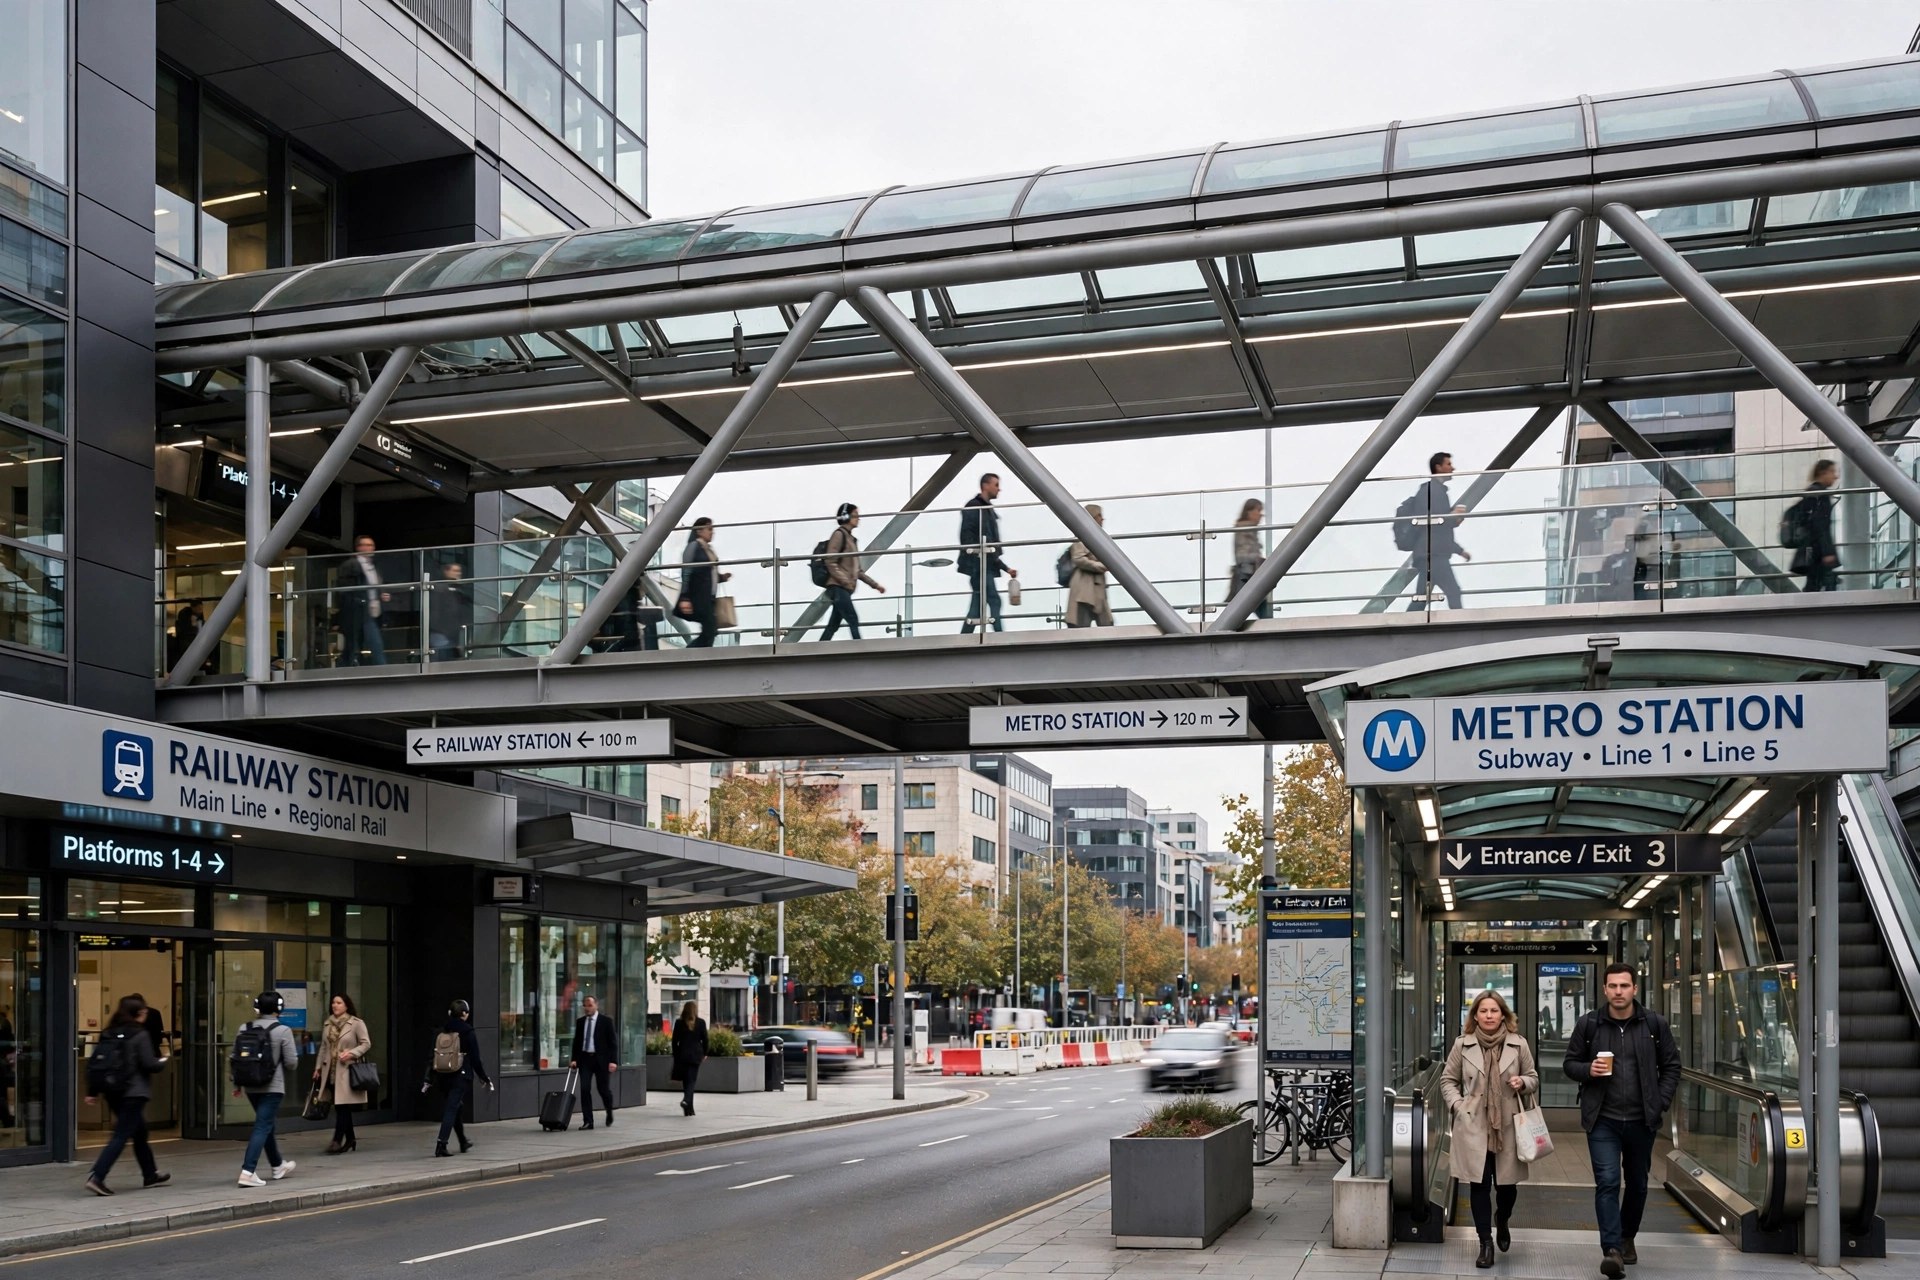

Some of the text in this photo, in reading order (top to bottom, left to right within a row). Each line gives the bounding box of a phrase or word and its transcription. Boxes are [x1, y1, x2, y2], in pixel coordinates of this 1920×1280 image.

[1005, 710, 1213, 732] METRO STATION 120 m
[1452, 694, 1804, 741] METRO STATION
[436, 732, 637, 753] RAILWAY STATION 100 m
[1371, 719, 1418, 759] M
[1478, 739, 1779, 772] Subway Line 1 Line 5
[170, 739, 409, 813] RAILWAY STATION
[180, 786, 387, 836] Main Line Regional Rail
[63, 835, 202, 872] Platforms 1-4
[1481, 839, 1666, 867] Entrance / Exit 3
[1791, 1132, 1800, 1145] 3
